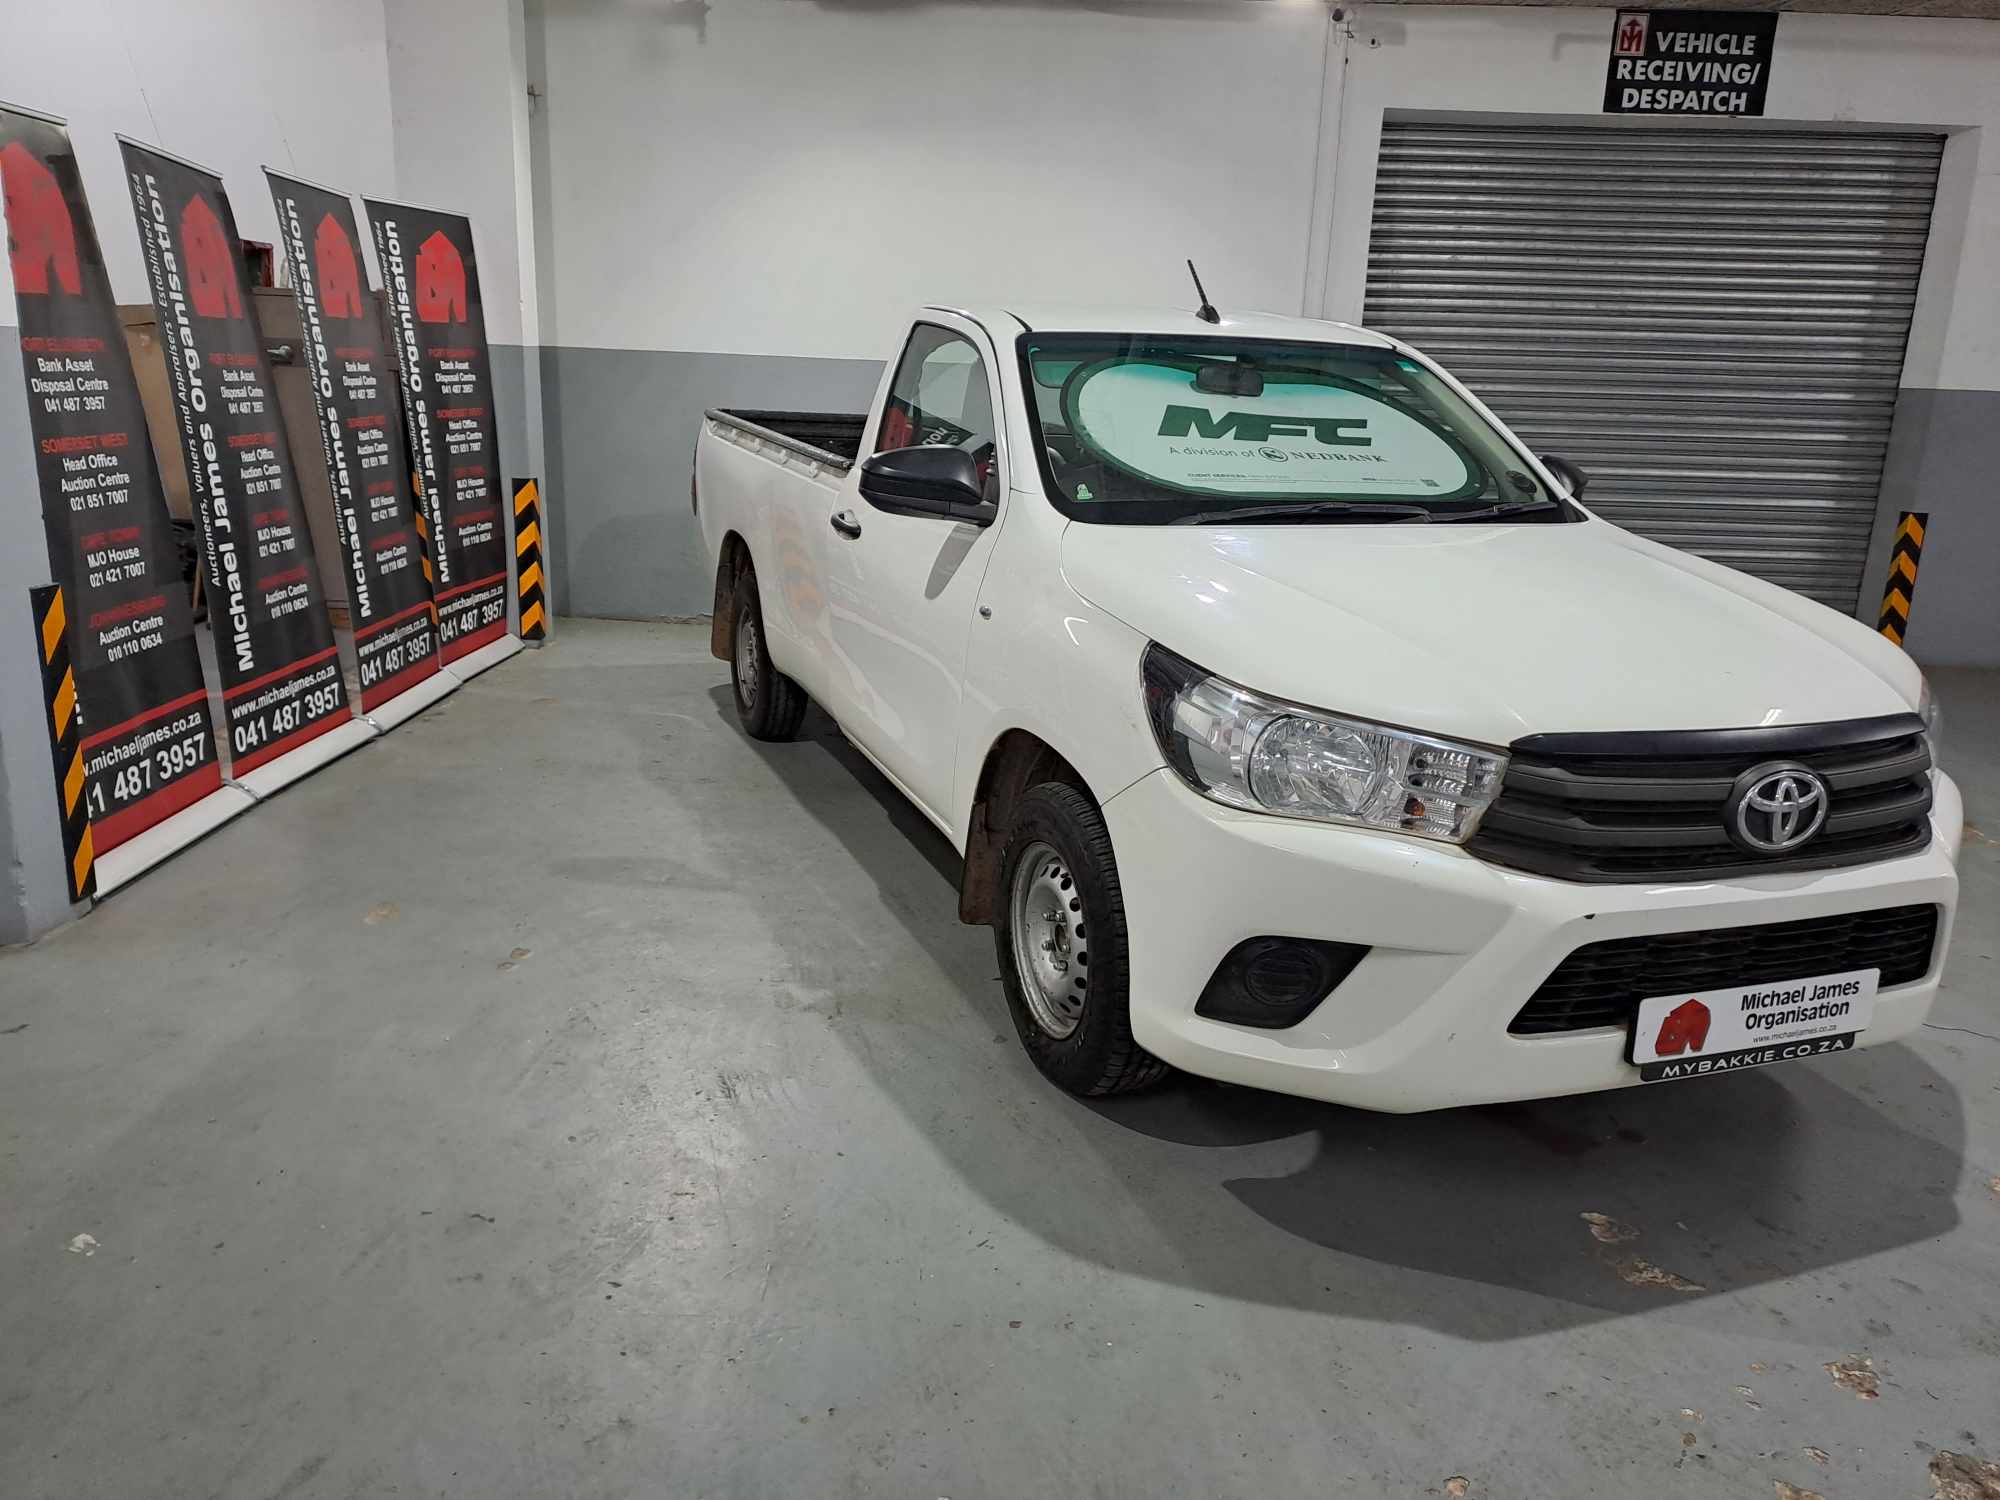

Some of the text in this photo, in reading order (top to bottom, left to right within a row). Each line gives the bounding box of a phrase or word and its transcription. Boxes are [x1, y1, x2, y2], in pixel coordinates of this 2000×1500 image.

[1656, 32, 1756, 55] VEHICLE
[1616, 59, 1762, 85] RECEIVING/
[1621, 88, 1748, 113] DESPATCH
[37, 358, 94, 372] Bank Asset
[31, 377, 109, 395] Disposal Centre
[44, 396, 105, 413] 041 487 3957
[286, 198, 372, 618] Michael James Organisation
[385, 220, 450, 583] Michael James Organisation
[145, 174, 255, 673] Michael James Organisation
[180, 404, 194, 435] and
[1158, 404, 1372, 447] MFC
[62, 454, 118, 472] Head Office
[189, 439, 205, 493] Valuers
[1169, 446, 1388, 463] A division of NEDBANK
[61, 472, 131, 493] Auction Centre
[70, 489, 129, 512] 021 851 7007
[86, 547, 140, 569] MJO House
[89, 562, 145, 588] 021 421 7007
[99, 616, 164, 646] Auction Centre
[440, 599, 504, 642] 041 487 3957
[108, 645, 123, 662] 010
[122, 640, 139, 656] 110
[361, 631, 430, 686] 041 487 3957
[232, 665, 336, 720] www.michaeljames.co.za
[234, 682, 339, 753] 041 487 3957
[114, 759, 151, 803] 487
[156, 732, 206, 781] 3957
[1741, 980, 1860, 1011] Michael James
[1746, 1001, 1849, 1030] Organisation
[1661, 1039, 1845, 1078] MYBAKKIE.CO.ZA
